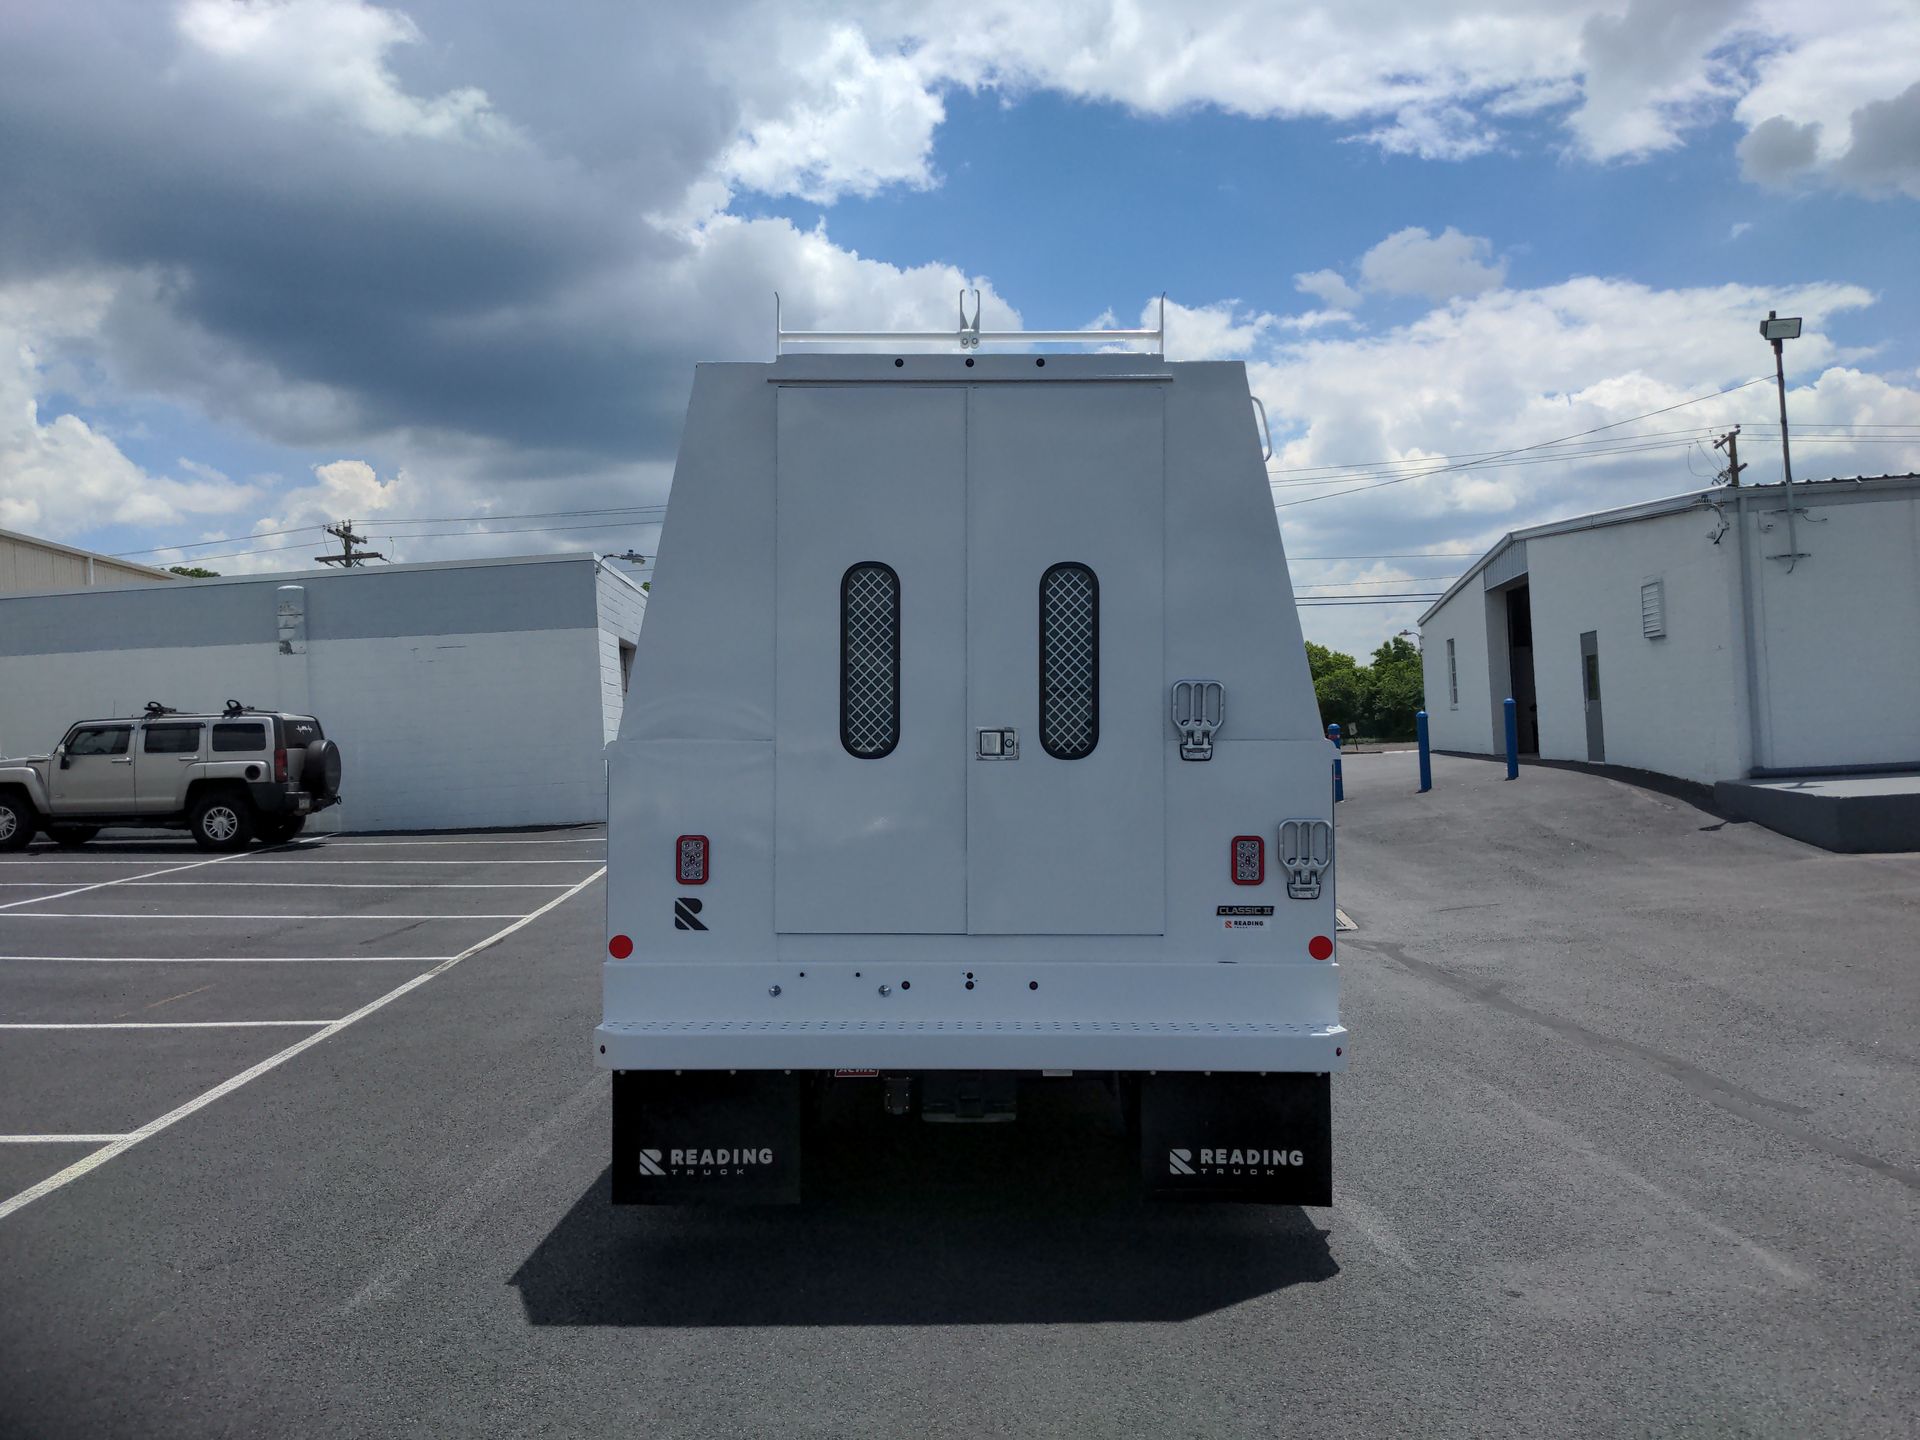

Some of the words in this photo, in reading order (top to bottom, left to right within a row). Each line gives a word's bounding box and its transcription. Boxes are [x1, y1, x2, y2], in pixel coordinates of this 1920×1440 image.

[1218, 906, 1262, 915] CLASSIC
[670, 1148, 774, 1166] READING
[1200, 1148, 1304, 1167] READING
[671, 1168, 745, 1176] TRUCK
